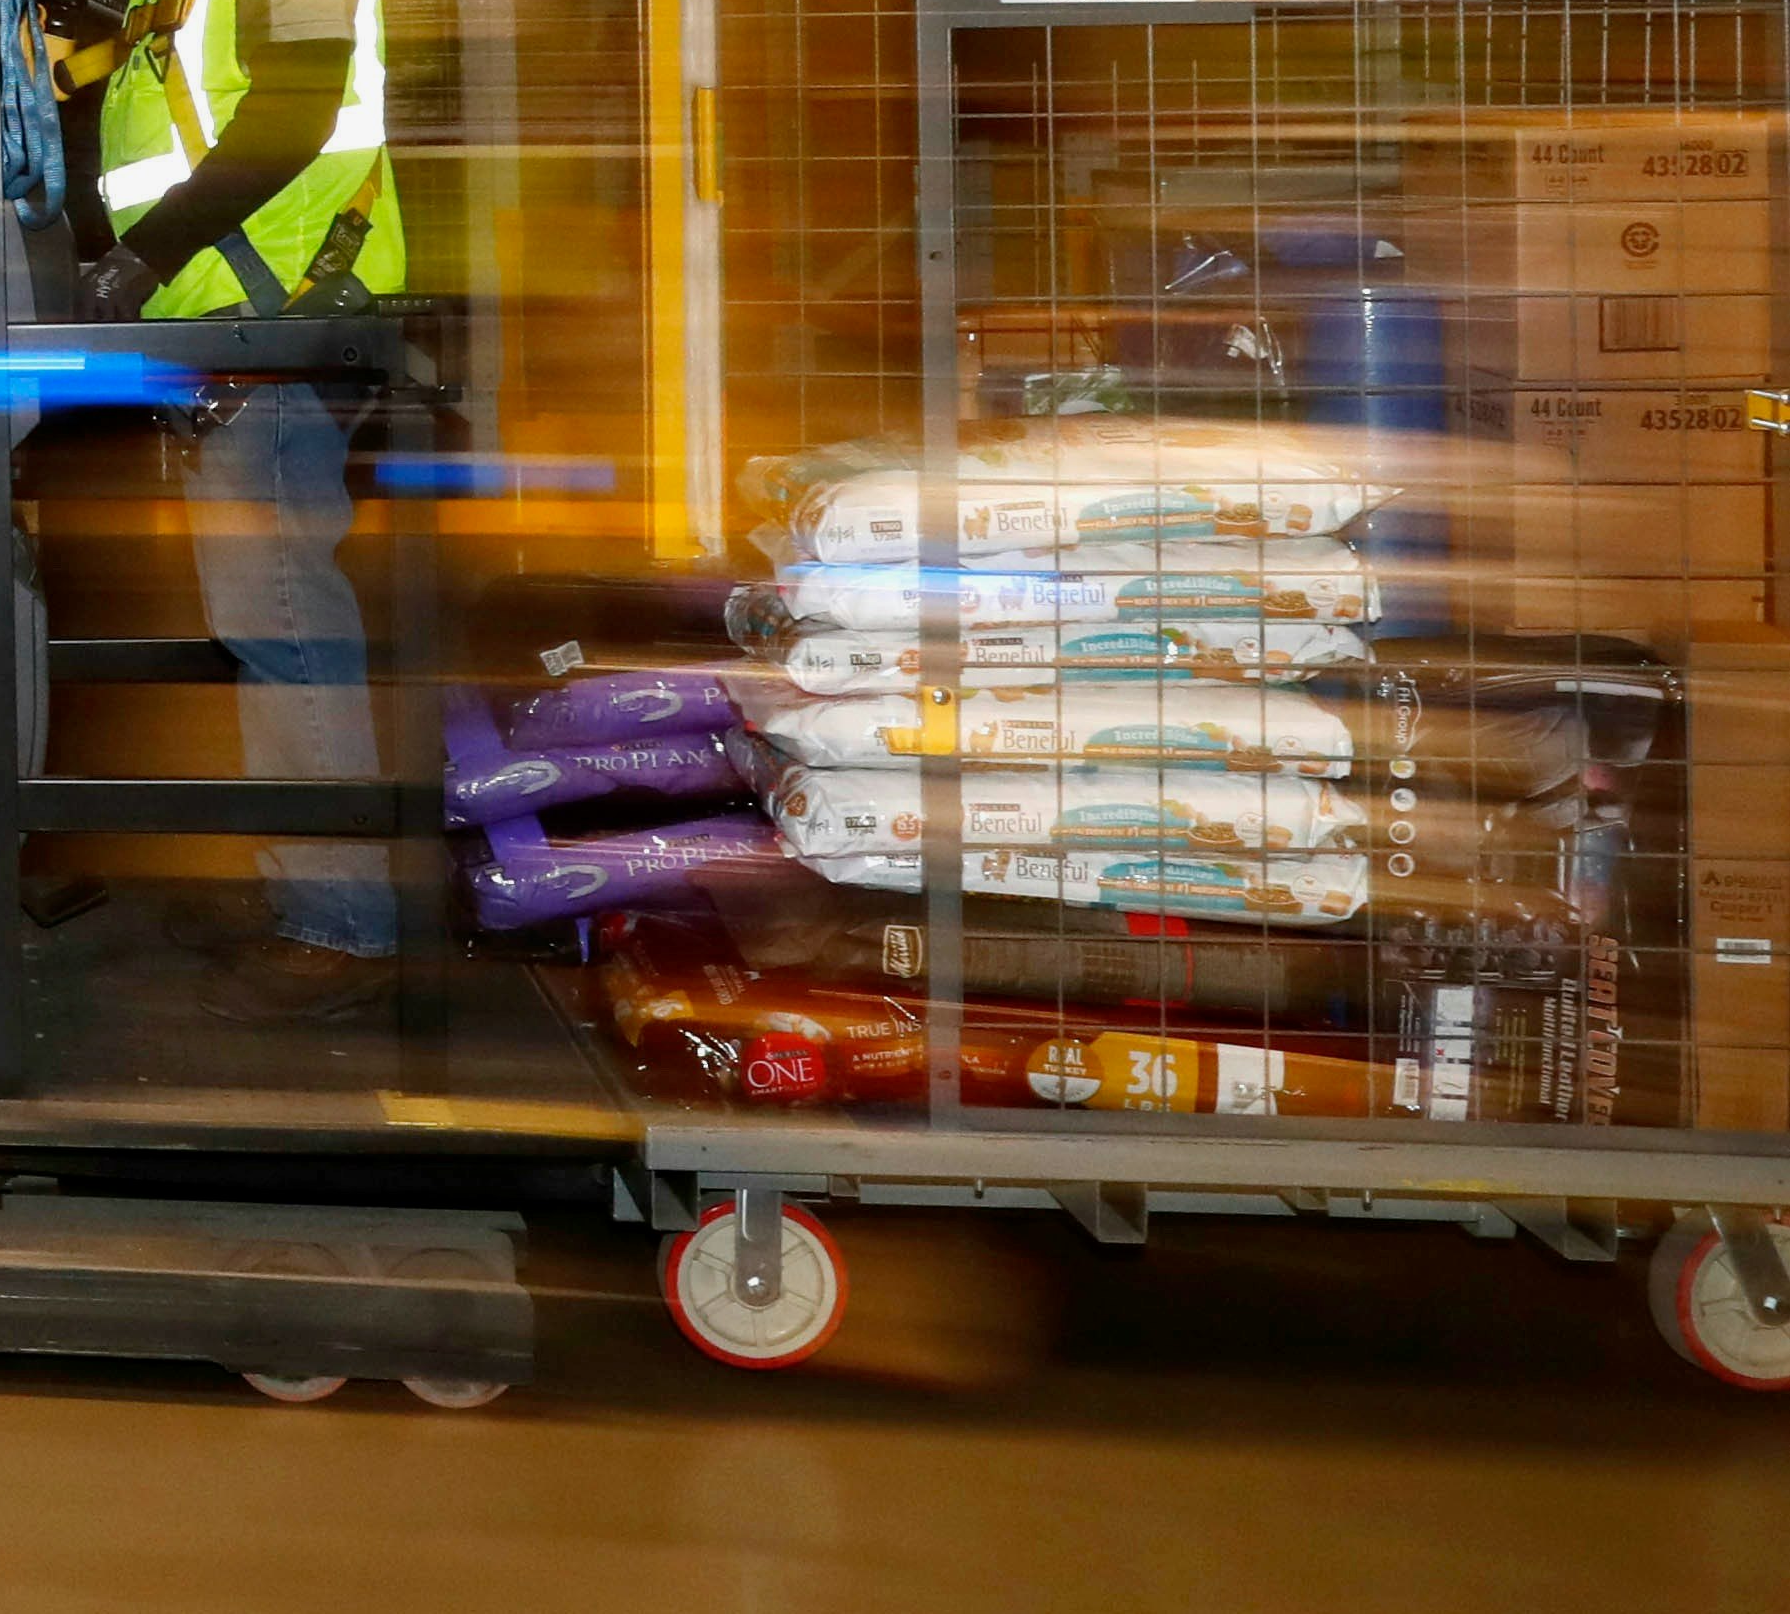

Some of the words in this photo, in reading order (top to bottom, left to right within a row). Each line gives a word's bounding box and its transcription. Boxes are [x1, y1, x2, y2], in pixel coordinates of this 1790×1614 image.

[1531, 143, 1553, 164] 44
[996, 507, 1070, 532] Beneful
[1033, 582, 1106, 606] Beneful
[974, 644, 1046, 663] Beneful
[1081, 638, 1160, 654] IncrediBite
[1397, 686, 1411, 703] FH
[1394, 705, 1412, 744] Group
[1003, 728, 1076, 750] Beneful
[971, 812, 1042, 833] Beneful
[1016, 857, 1089, 882] Beneful
[1587, 934, 1620, 1026] SEAT
[846, 1023, 892, 1040] TRUE
[1049, 1045, 1085, 1065] RAL
[747, 1057, 815, 1089] ONE
[1044, 1063, 1087, 1077] TUKEY
[1126, 1050, 1179, 1098] 36
